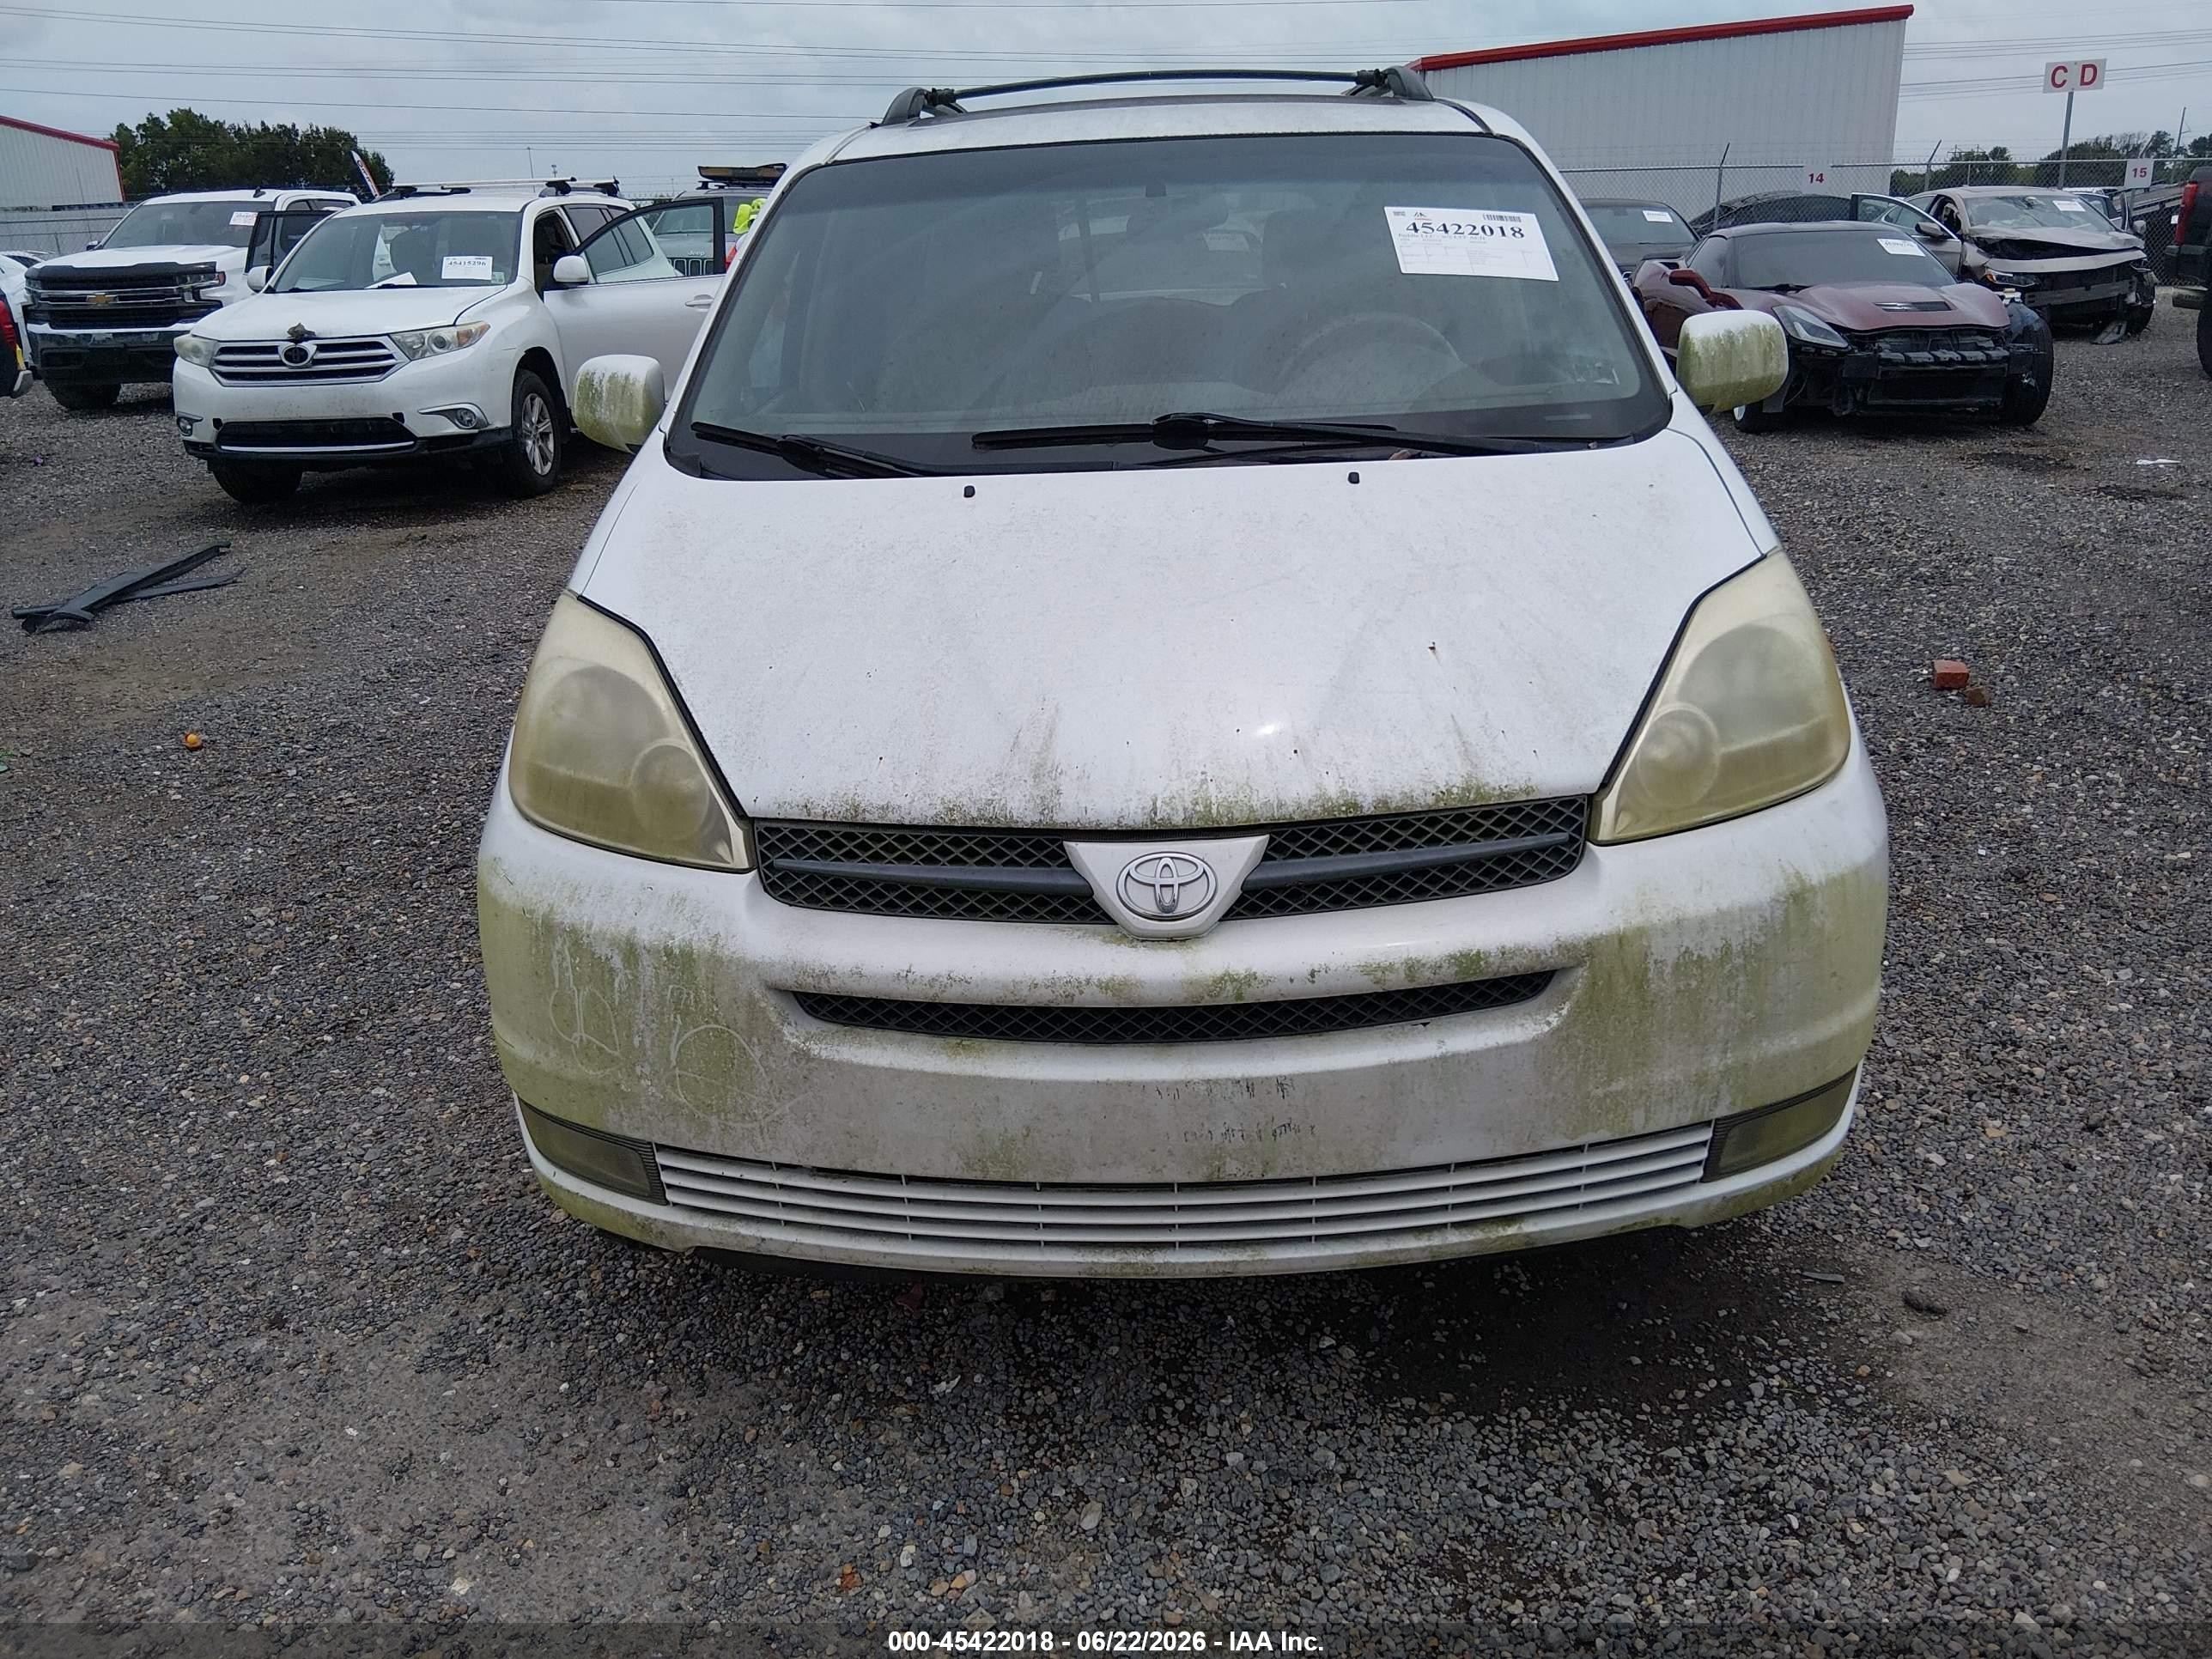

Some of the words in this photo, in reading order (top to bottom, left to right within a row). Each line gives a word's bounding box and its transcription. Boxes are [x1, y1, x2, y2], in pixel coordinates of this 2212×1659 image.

[2051, 65, 2069, 88] C
[2080, 64, 2098, 87] D
[1808, 173, 1825, 184] 14
[2132, 167, 2148, 179] 15
[1406, 222, 1525, 240] 45422018
